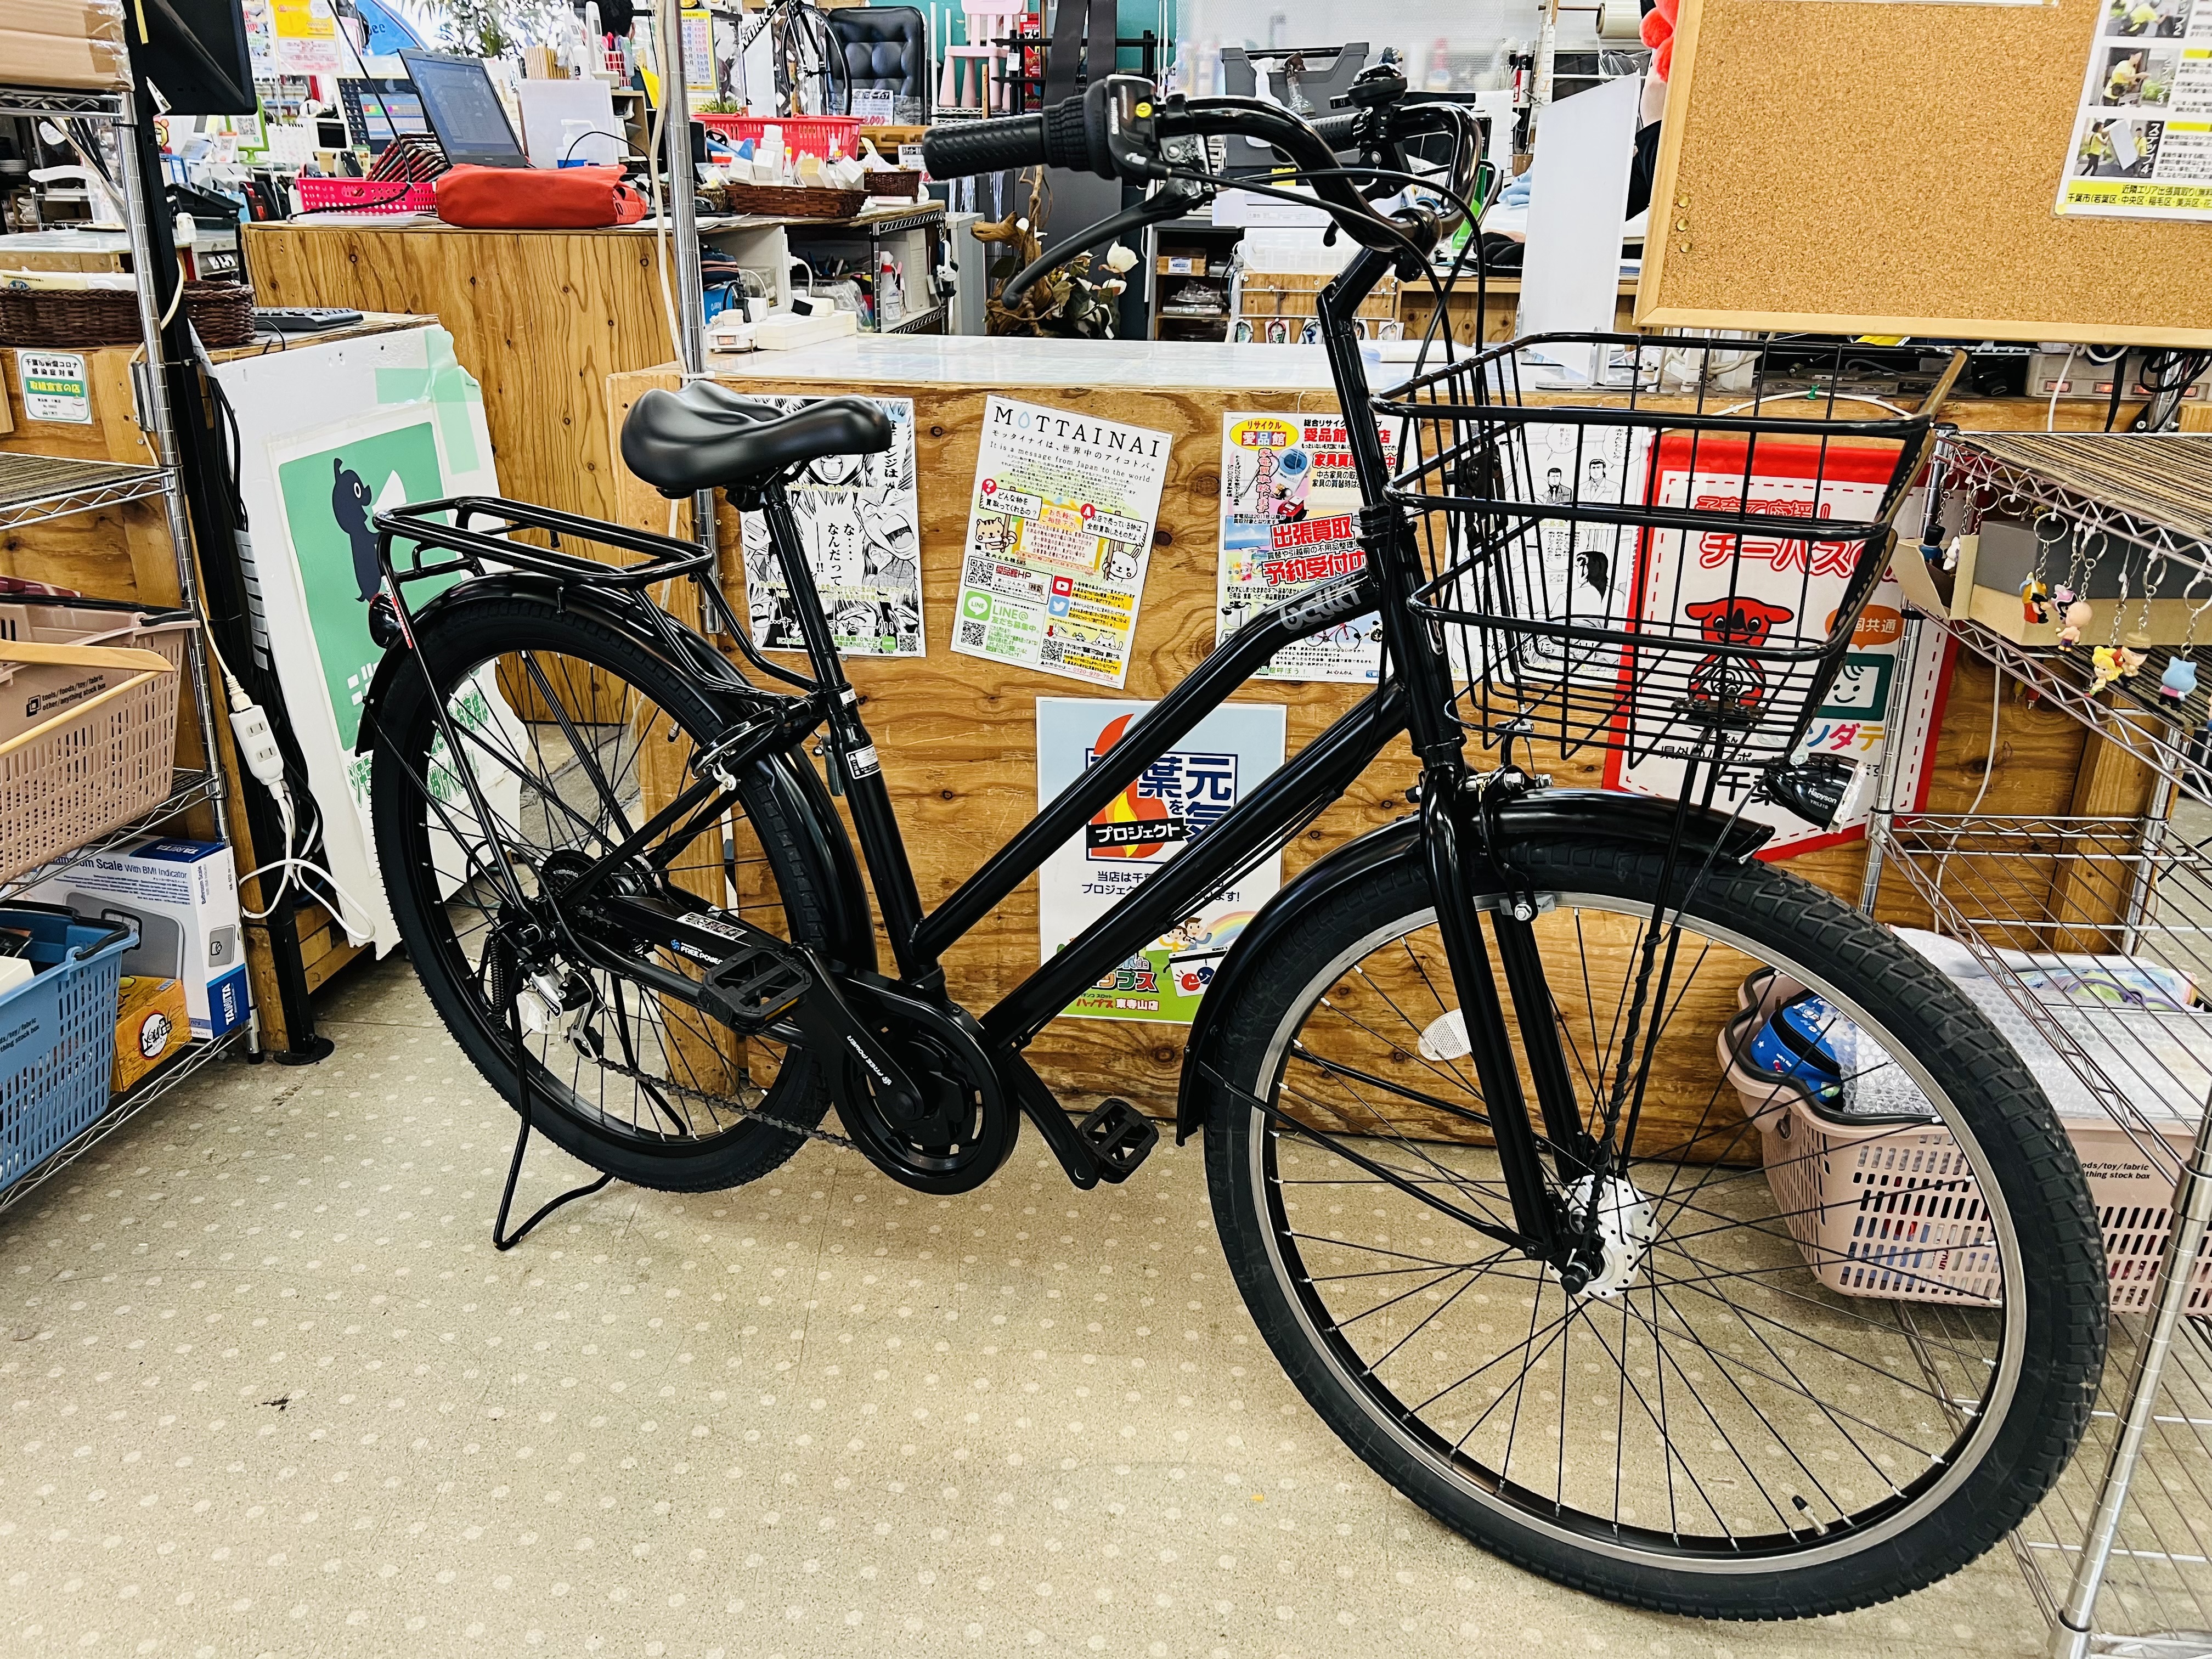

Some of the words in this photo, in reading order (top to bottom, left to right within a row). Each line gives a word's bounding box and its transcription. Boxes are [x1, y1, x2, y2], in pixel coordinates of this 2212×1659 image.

[1247, 421, 1282, 430] リサイクル
[1242, 431, 1286, 446] 愛品館
[1018, 448, 1052, 461] message
[1055, 454, 1074, 466] from
[1076, 460, 1098, 474] Japan
[1112, 469, 1125, 477] the
[997, 492, 1028, 505] どんな物を
[1048, 509, 1075, 521] お気軽に
[1273, 516, 1353, 549] 出張買取
[828, 522, 840, 586] なんだって
[995, 565, 1031, 580] 愛品館HP
[992, 605, 1029, 621] LINE@
[990, 616, 1040, 633] 友だち募集中。
[1854, 617, 1897, 634] 国共通
[83, 686, 97, 696] stock
[1808, 723, 1886, 752] ソダテ
[1808, 787, 1837, 805] Hapyson
[1169, 800, 1184, 815] を
[1095, 823, 1183, 843] プロジェクト
[97, 858, 123, 871] Scale
[125, 864, 141, 873] With
[143, 866, 157, 876] BMI
[158, 868, 187, 879] Indicator
[680, 946, 699, 958] FREE
[222, 983, 235, 1025] TANITA
[1115, 998, 1159, 1011] 東寺山店
[15, 1030, 30, 1044] stock
[31, 1024, 40, 1033] box
[847, 1035, 868, 1059] POWER
[865, 1058, 884, 1076] FREE
